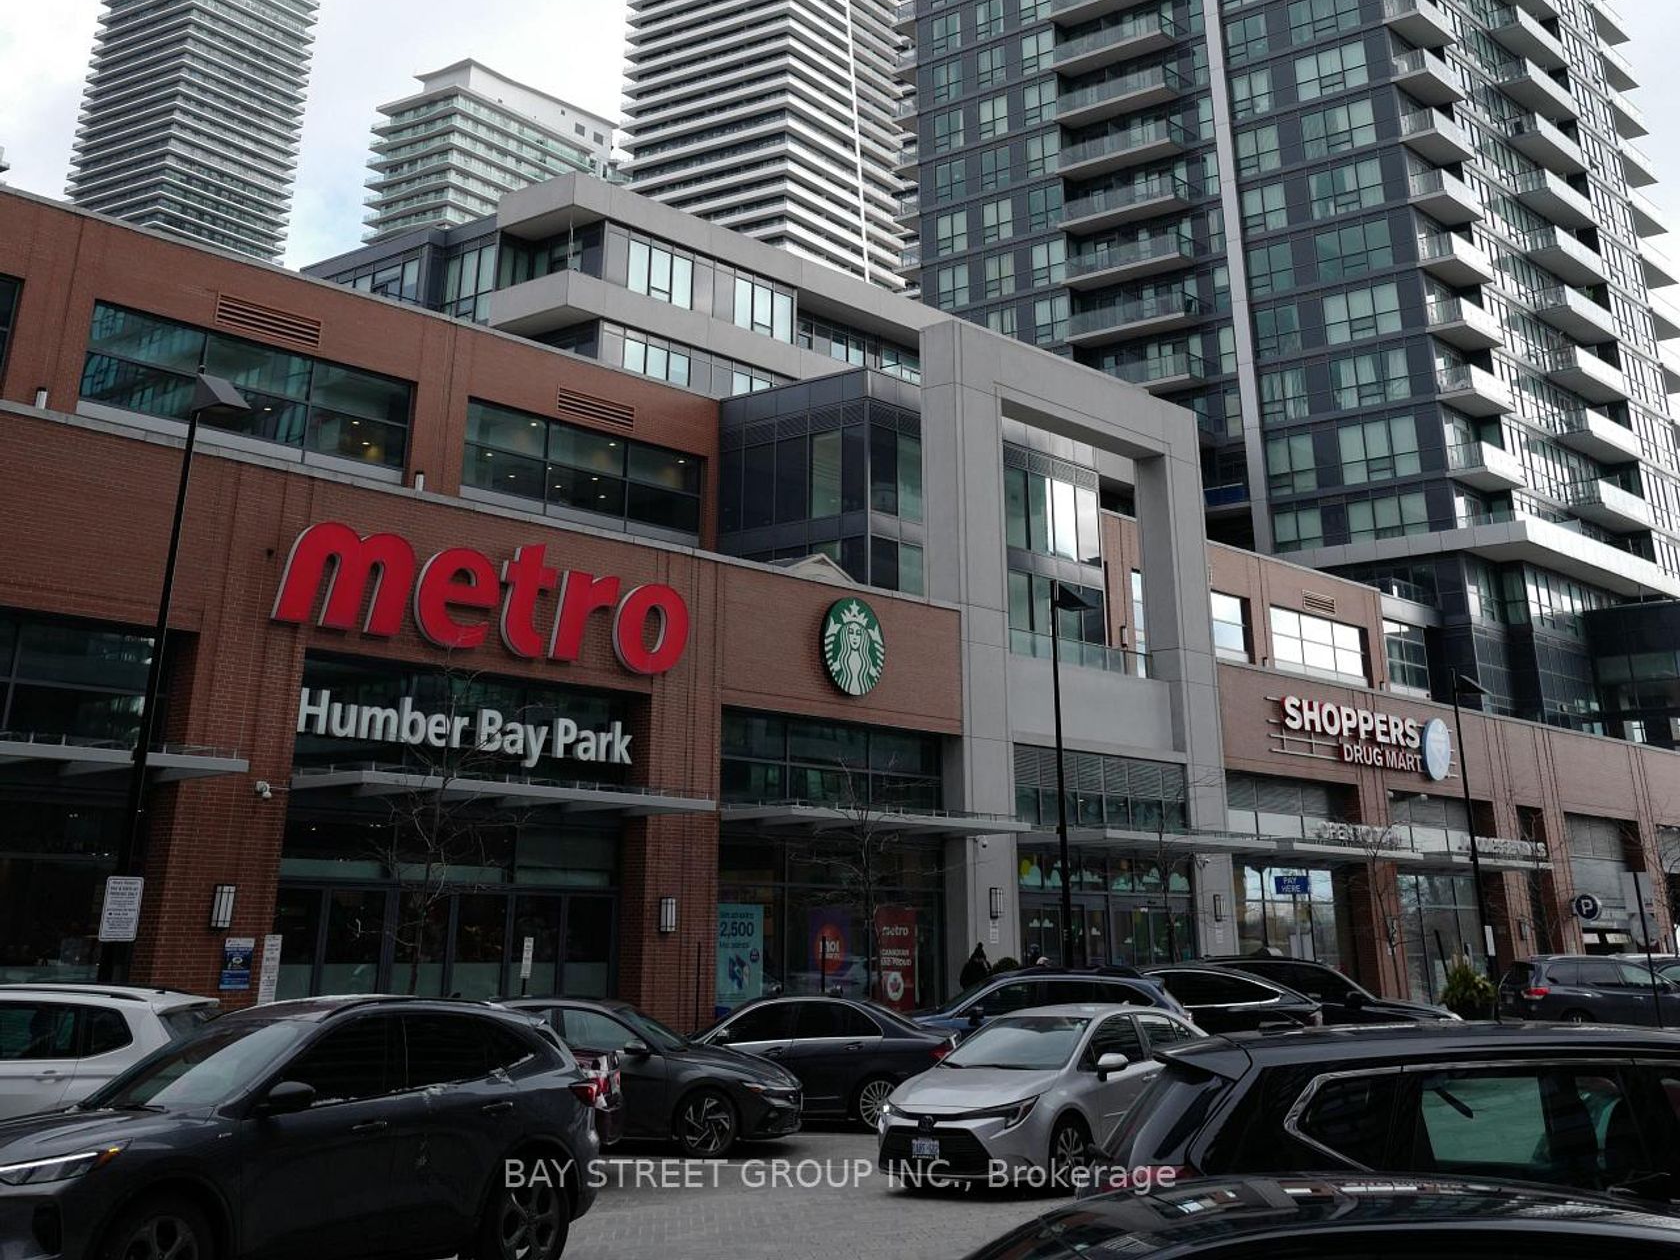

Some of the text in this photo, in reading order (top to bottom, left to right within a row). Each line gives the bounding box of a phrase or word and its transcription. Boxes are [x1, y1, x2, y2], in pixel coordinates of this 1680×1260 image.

[271, 522, 690, 674] metro
[296, 687, 633, 768] Humber Bay Park
[1281, 695, 1421, 749] SHOPPERS
[1341, 742, 1424, 773] DRUG MART
[1580, 898, 1594, 915] P
[720, 921, 754, 939] 2,500
